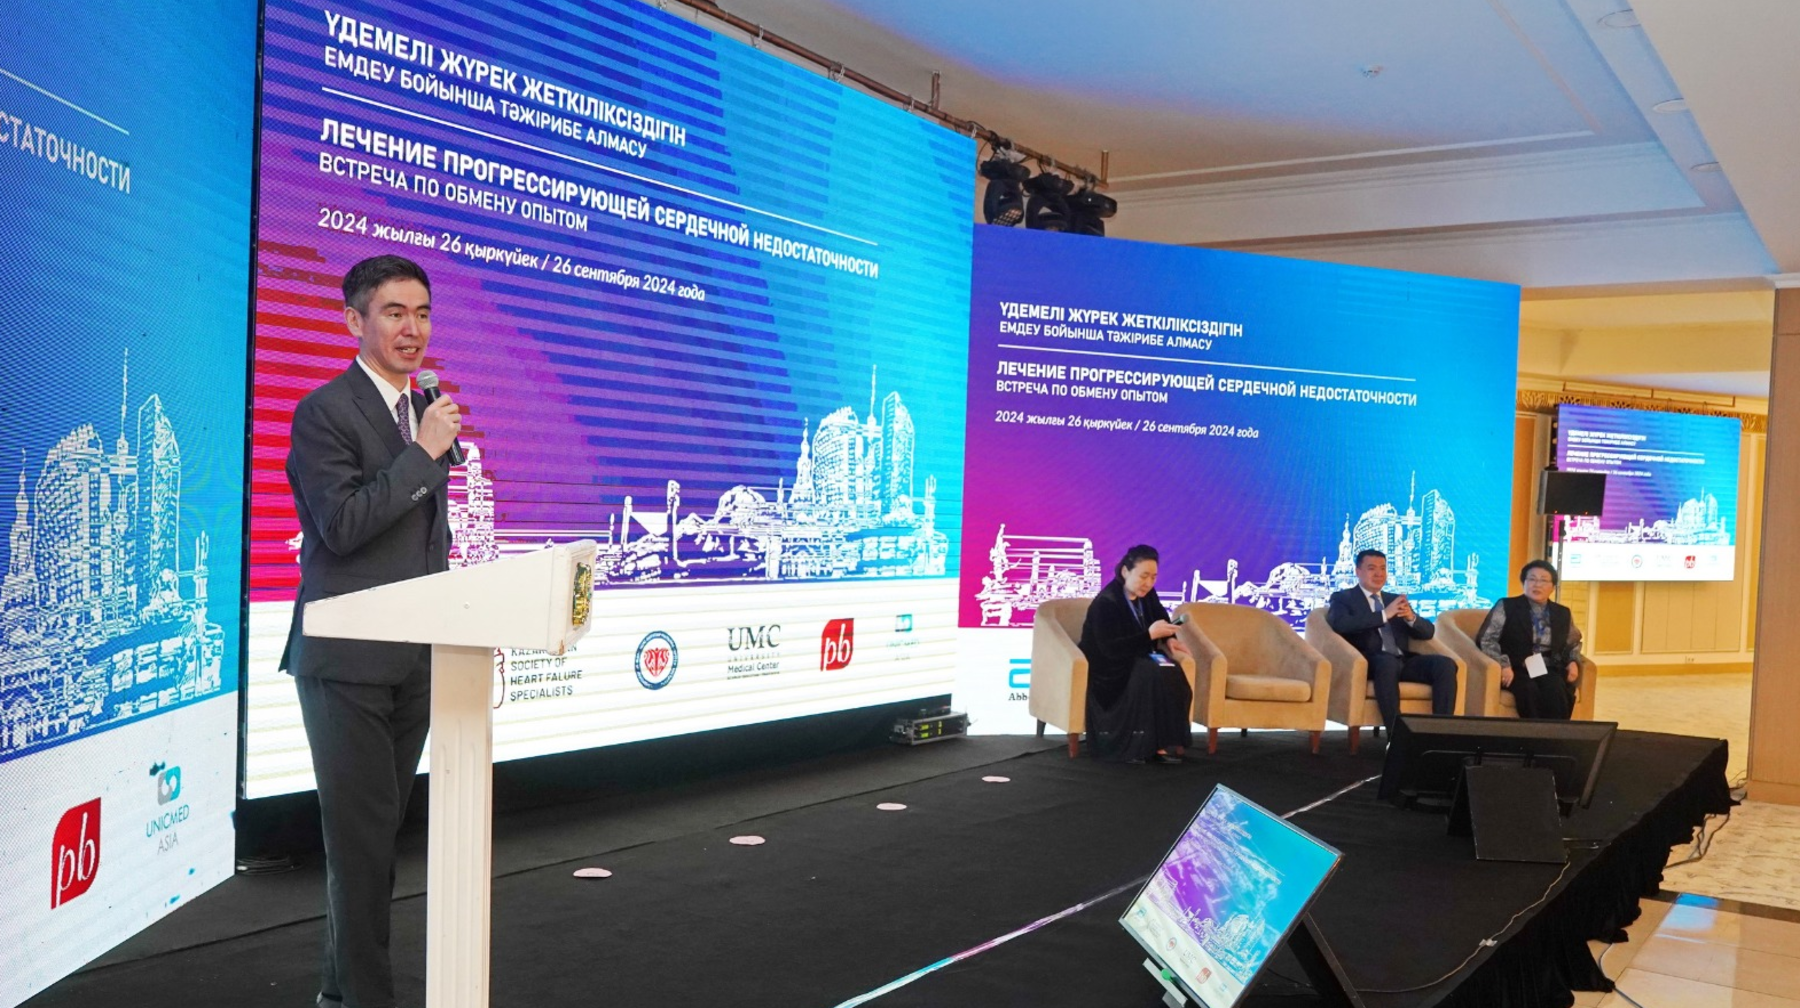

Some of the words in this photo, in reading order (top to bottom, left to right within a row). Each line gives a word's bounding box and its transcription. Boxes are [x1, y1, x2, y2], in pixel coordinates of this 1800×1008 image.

[324, 10, 433, 67] ҮДЕМЕЛІ
[440, 49, 517, 94] ЖҮРЕК
[522, 75, 686, 147] ЖЕТКІЛІКСІЗДІГІН
[325, 46, 394, 84] ЕМДЕУ
[400, 70, 495, 115] БОЙЫНША
[500, 99, 582, 141] ТӘЖІРИБЕ
[586, 126, 647, 159] АЛМАСУ
[319, 152, 408, 191] ВСТРЕЧА
[414, 175, 439, 198] ПО
[445, 182, 516, 216] ОБМЕНУ
[521, 201, 588, 232] ОПЫТОМ
[321, 118, 437, 169] ЛЕЧЕНИЕ
[444, 149, 650, 222] ПРОГРЕССИРУЮЩЕЙ
[655, 206, 749, 247] СЕРДЕЧНОЙ
[754, 231, 878, 279] НЕДОСТАТОЧНОСТИ
[318, 207, 368, 235] 2024
[372, 223, 435, 248] жылғы
[439, 233, 461, 253] 26
[541, 254, 550, 270] /
[553, 256, 571, 275] 26
[574, 264, 640, 289] сентября
[643, 274, 676, 297] 2024
[678, 285, 705, 301] года
[1000, 301, 1064, 321] ҮДЕМЕЛІ
[1068, 308, 1118, 326] ЖҮРЕК
[1122, 313, 1242, 337] ЖЕТКІЛІКСІЗДІГІН
[1000, 321, 1041, 336] ЕМДЕУ
[1044, 324, 1104, 341] БОЙЫНША
[1107, 330, 1164, 346] ТӘЖІРИБЕ
[1166, 336, 1212, 350] АЛМАСУ
[997, 361, 1066, 379] ЛЕЧЕНИЕ
[1070, 366, 1214, 391] ПРОГРЕССИРУЮЩЕЙ
[1218, 378, 1296, 397] СЕРДЕЧНОЙ
[1300, 385, 1417, 406] НЕДОСТАТОЧНОСТИ
[997, 380, 1048, 395] ВСТРЕЧА
[1052, 384, 1068, 396] ПО
[1071, 386, 1118, 400] ОБМЕНУ
[1121, 389, 1168, 403] ОПЫТОМ
[995, 411, 1024, 424] 2024
[1068, 415, 1081, 428] 26
[1134, 419, 1141, 431] /
[1142, 420, 1156, 432] 26
[1158, 422, 1207, 436] сентября
[1209, 424, 1234, 437] 2024
[1236, 427, 1259, 438] года
[727, 624, 781, 651] UMC
[823, 623, 850, 670] pb
[510, 673, 543, 686] HEART
[511, 658, 552, 671] SOCIETY
[555, 657, 567, 667] OF
[728, 663, 755, 673] Medical
[757, 662, 779, 670] Center
[510, 685, 573, 701] SPECIALISTS
[1008, 692, 1030, 701] Abb
[146, 804, 190, 837] UNICMED
[158, 832, 179, 854] ASIA
[55, 812, 96, 907] pb
